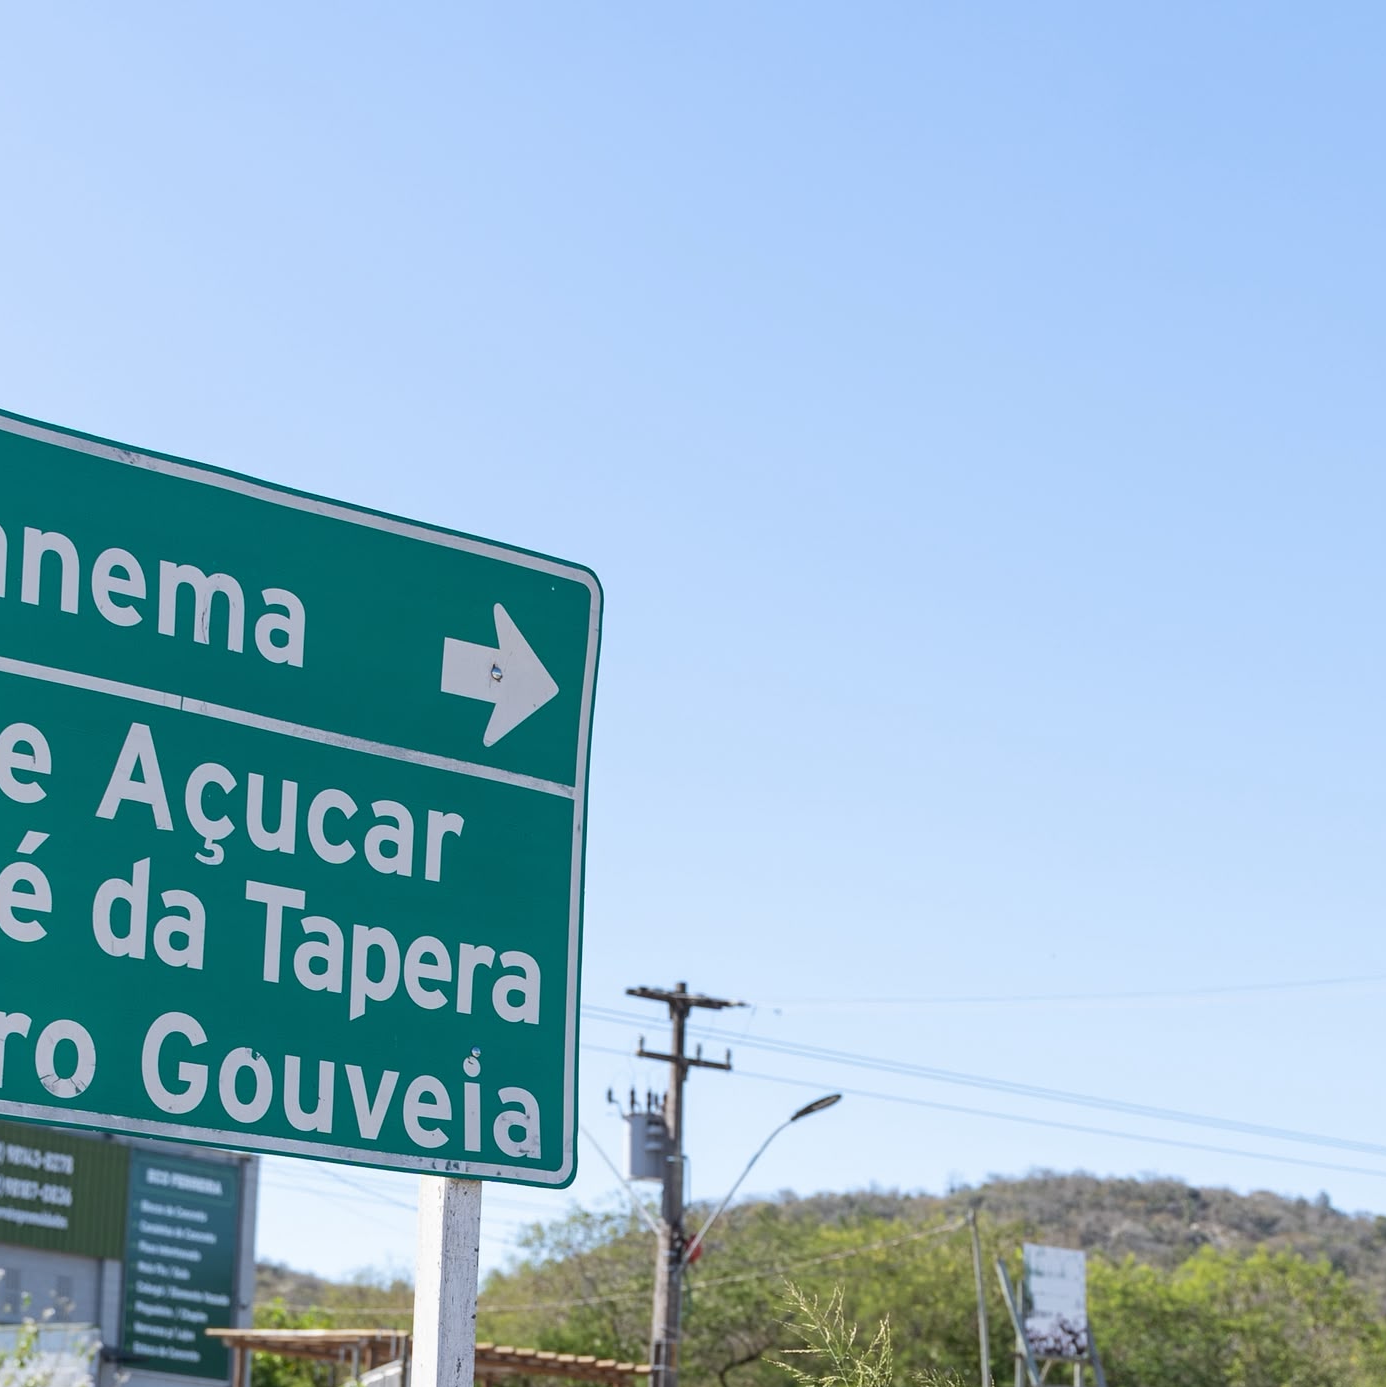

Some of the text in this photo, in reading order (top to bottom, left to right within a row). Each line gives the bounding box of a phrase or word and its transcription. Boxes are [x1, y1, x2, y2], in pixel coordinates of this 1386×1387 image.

[96, 723, 464, 882] Açucar
[93, 858, 205, 970] da
[246, 881, 541, 1025] Tapera
[142, 1012, 541, 1159] Gouveia
